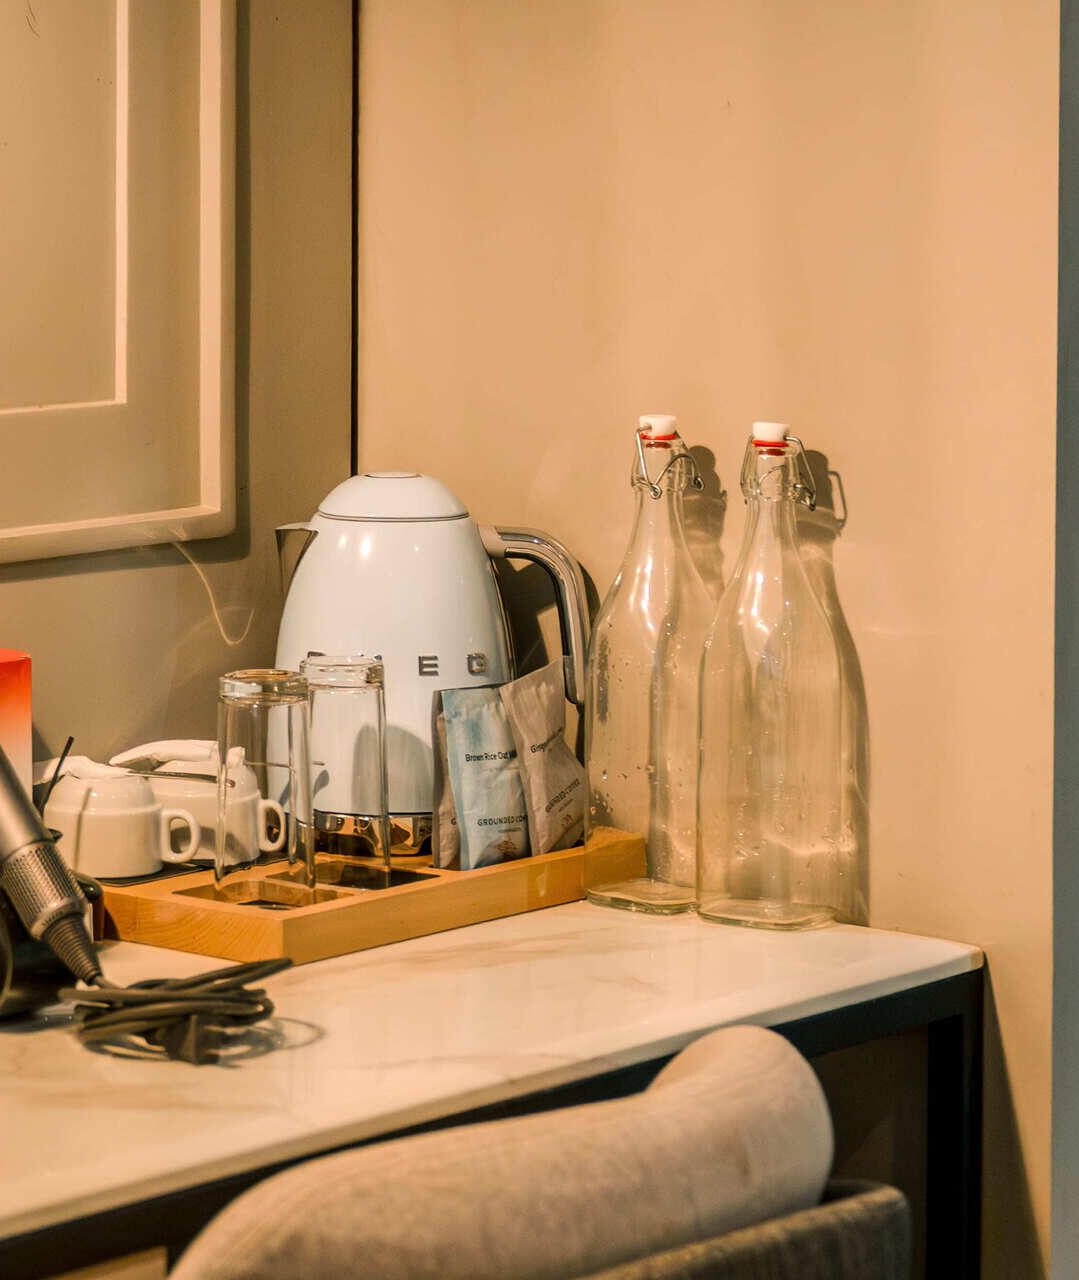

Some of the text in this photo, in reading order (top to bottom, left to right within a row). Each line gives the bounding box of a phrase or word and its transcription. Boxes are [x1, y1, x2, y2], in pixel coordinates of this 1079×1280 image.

[306, 651, 487, 677] EG
[465, 753, 484, 762] Brown
[484, 752, 497, 760] Rice
[477, 815, 514, 827] GROUNDED
